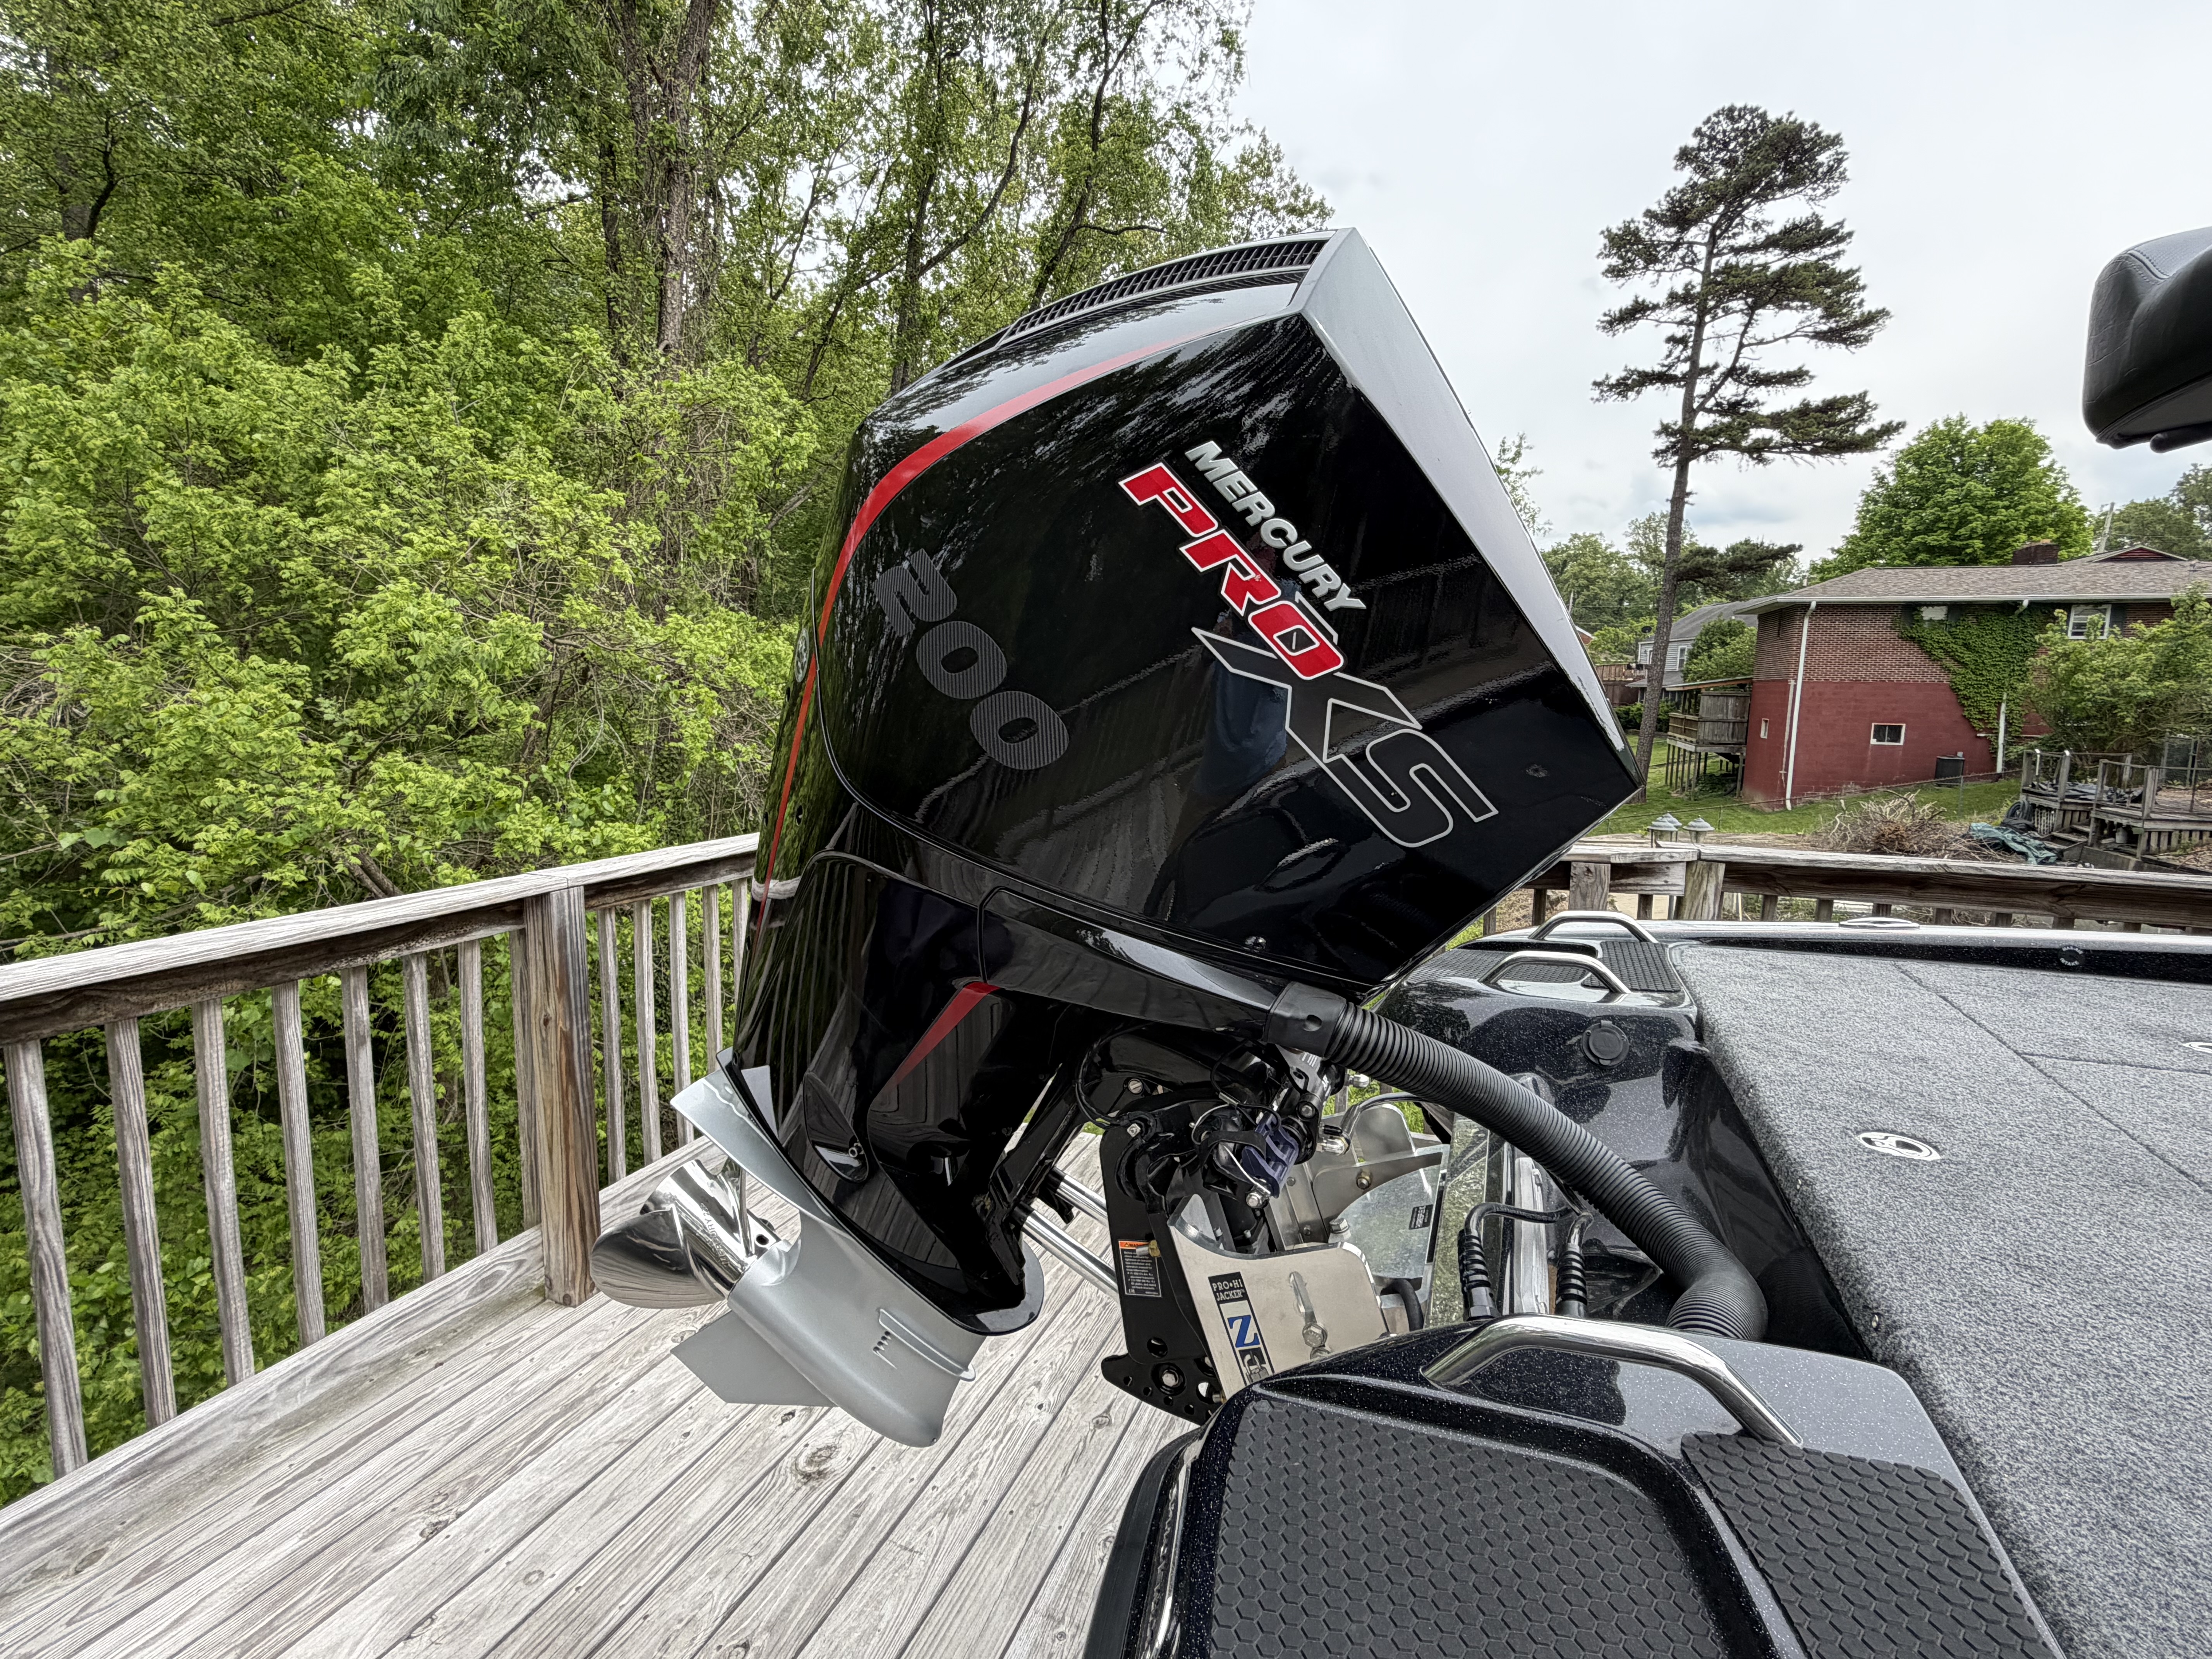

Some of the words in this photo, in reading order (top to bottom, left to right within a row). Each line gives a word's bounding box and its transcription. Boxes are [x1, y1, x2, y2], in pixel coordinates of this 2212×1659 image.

[1118, 462, 1345, 680] PRO
[1185, 440, 1367, 613] MERCURY
[872, 548, 1069, 770] 200
[1191, 591, 1499, 848] XS
[1227, 1314, 1260, 1348] Z
